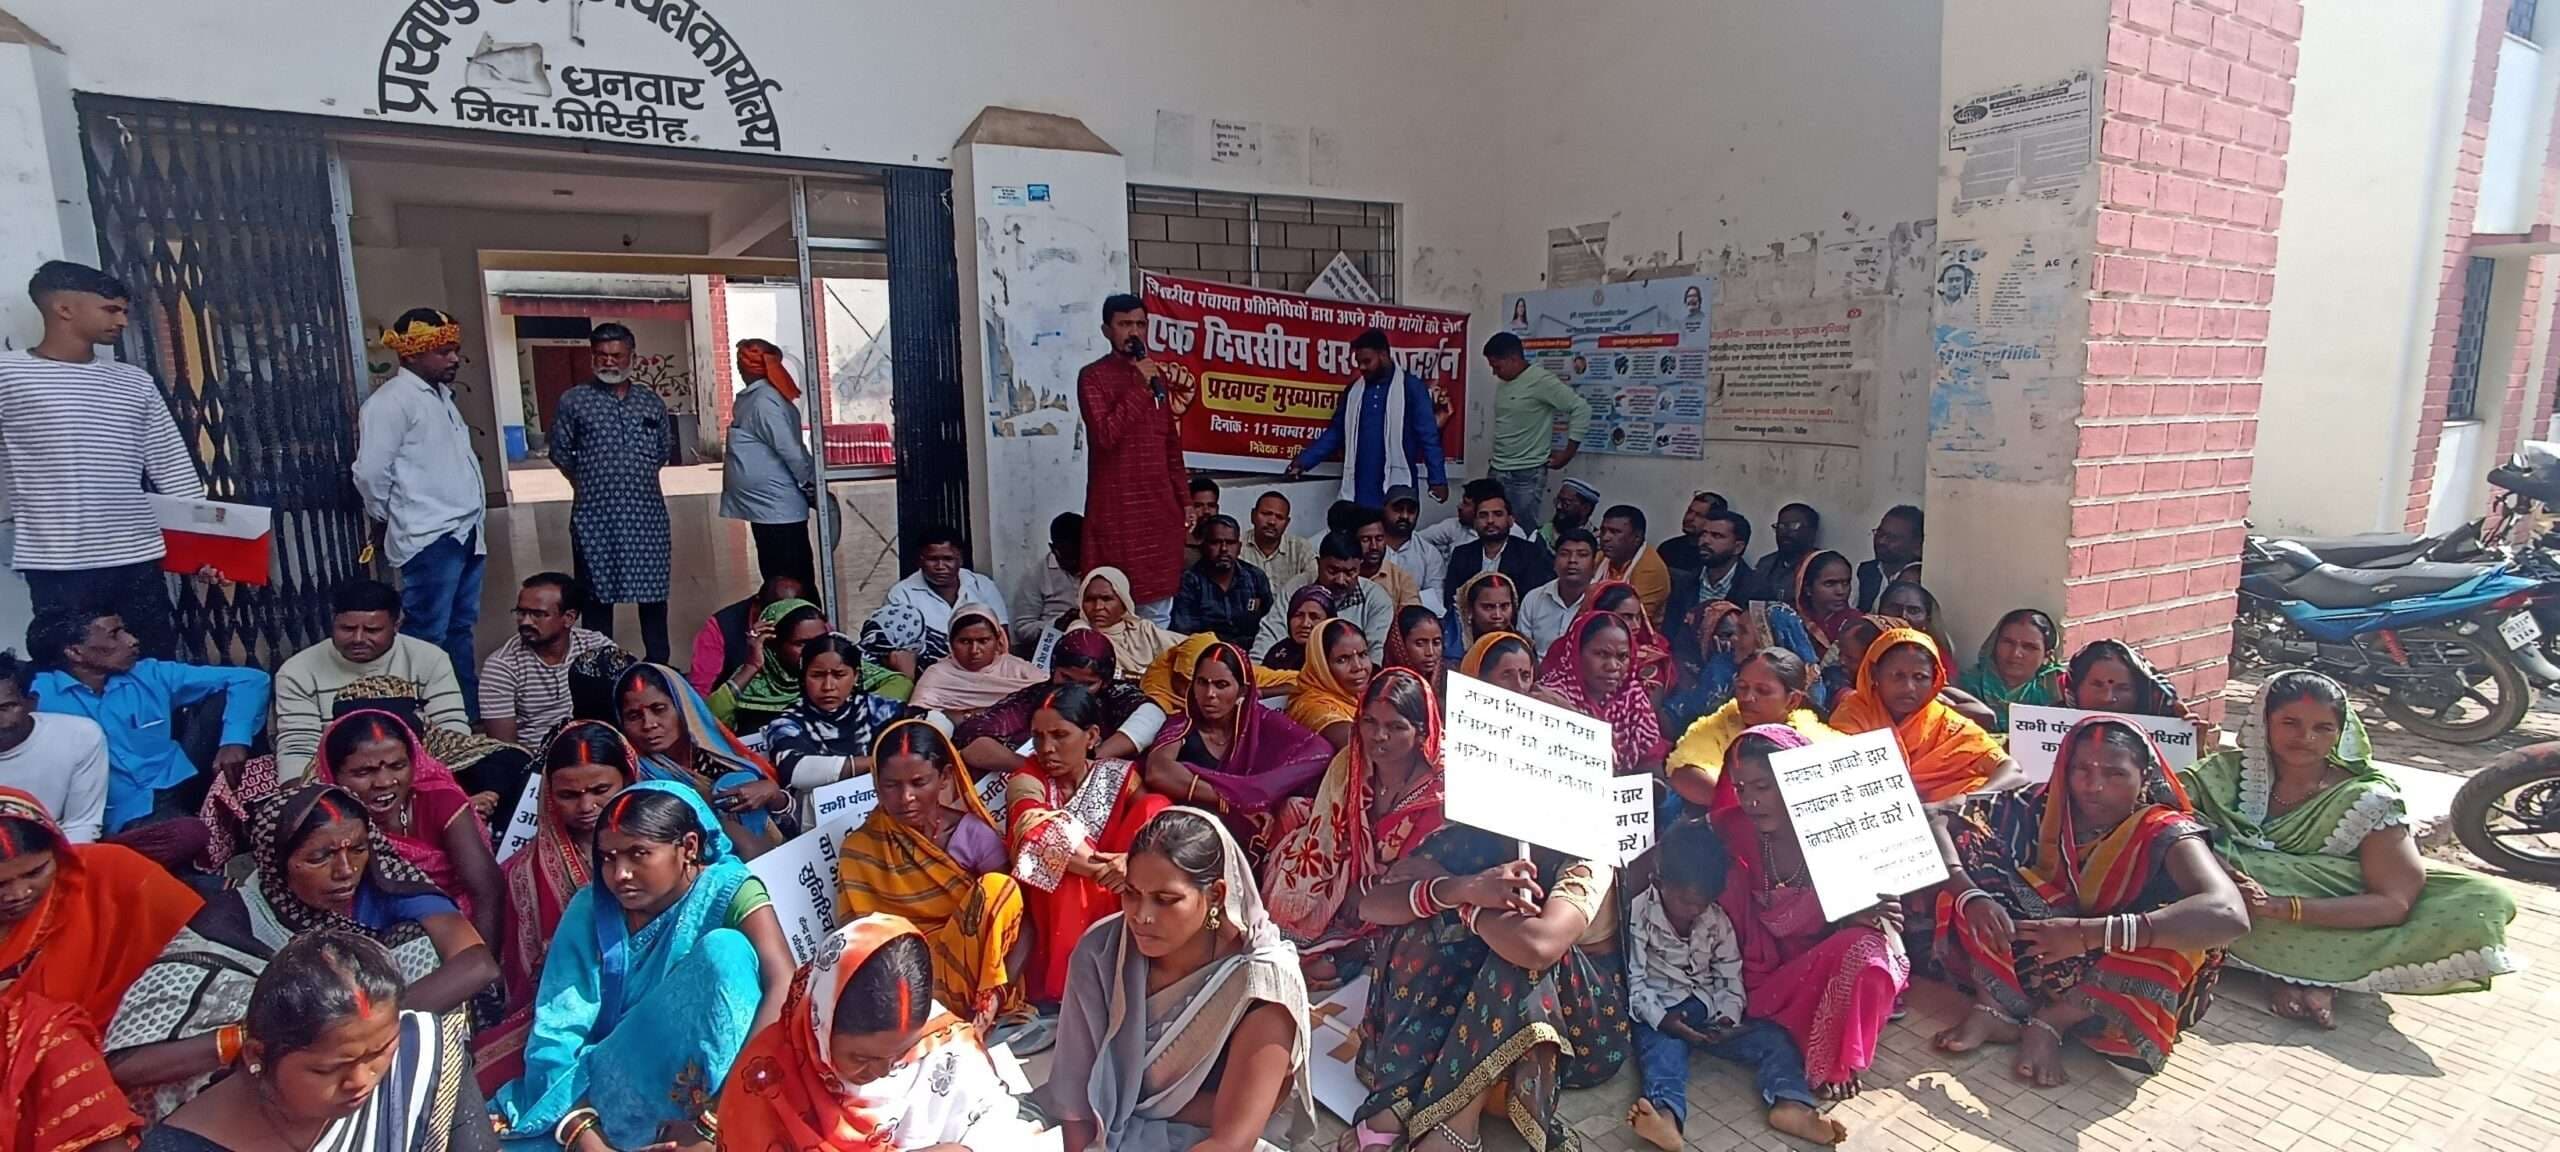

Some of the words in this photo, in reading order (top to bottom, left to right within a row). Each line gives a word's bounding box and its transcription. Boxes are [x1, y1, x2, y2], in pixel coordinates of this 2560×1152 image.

[561, 66, 705, 110] धनवार
[1198, 288, 1241, 312] पंचायत
[1243, 294, 1309, 320] प्रतिनिधियों
[1337, 307, 1365, 327] अपने
[1147, 313, 1199, 356] एक
[1203, 315, 1310, 373] दिवसीय
[1208, 377, 1270, 404] प्रखण्ड
[1272, 384, 1339, 413] मुख्याल
[1254, 423, 1268, 436] 11
[2015, 718, 2047, 732] सभी
[1885, 774, 1905, 790] पर
[819, 795, 846, 815] सभी
[1630, 811, 1648, 824] पर
